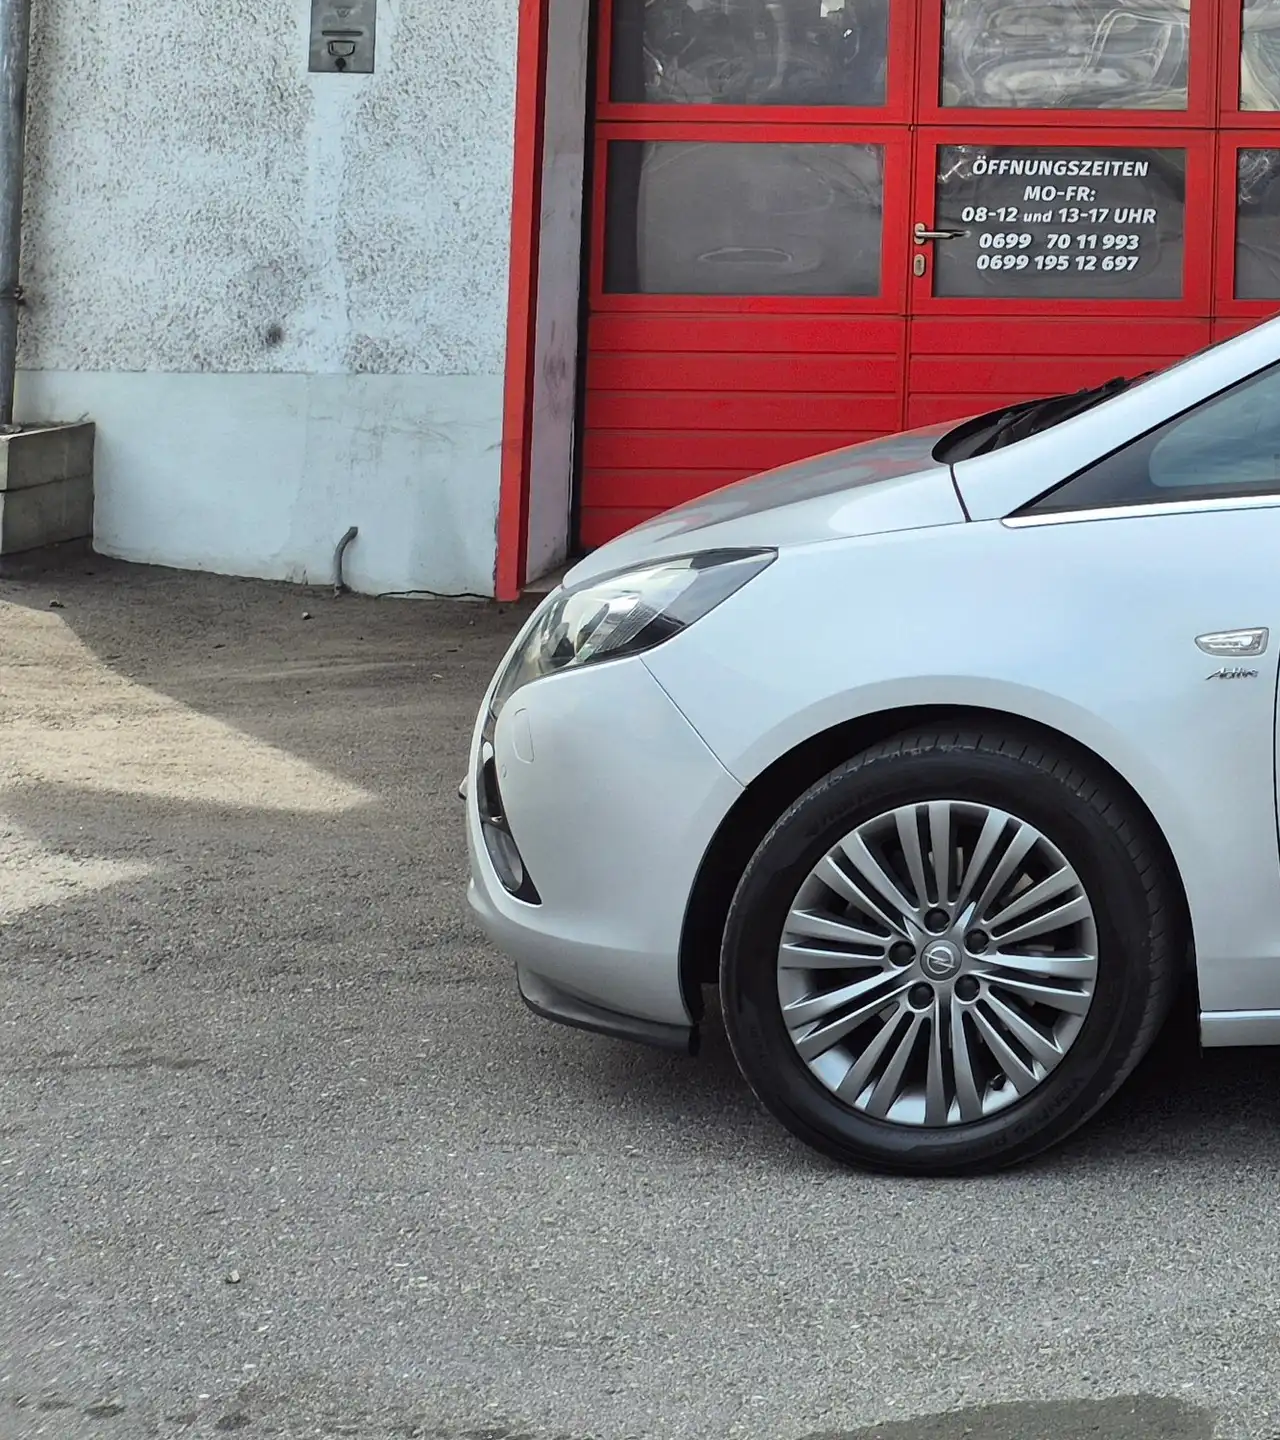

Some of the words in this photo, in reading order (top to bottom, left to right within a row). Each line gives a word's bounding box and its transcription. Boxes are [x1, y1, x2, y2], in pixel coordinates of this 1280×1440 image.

[972, 156, 1149, 177] ÖFFNUNGSZEITEN
[1023, 185, 1096, 202] MO-FR:
[961, 207, 1018, 222] 08-12
[1023, 210, 1052, 223] und
[1058, 208, 1109, 224] 13-17
[1114, 208, 1157, 225] UHR
[979, 233, 1032, 250] 0699
[1047, 234, 1071, 250] 70
[1076, 234, 1097, 250] 11
[1102, 234, 1140, 250] 993
[976, 254, 1029, 270] 0699
[1034, 254, 1069, 270] 195
[1075, 255, 1096, 271] 12
[1102, 255, 1139, 272] 697
